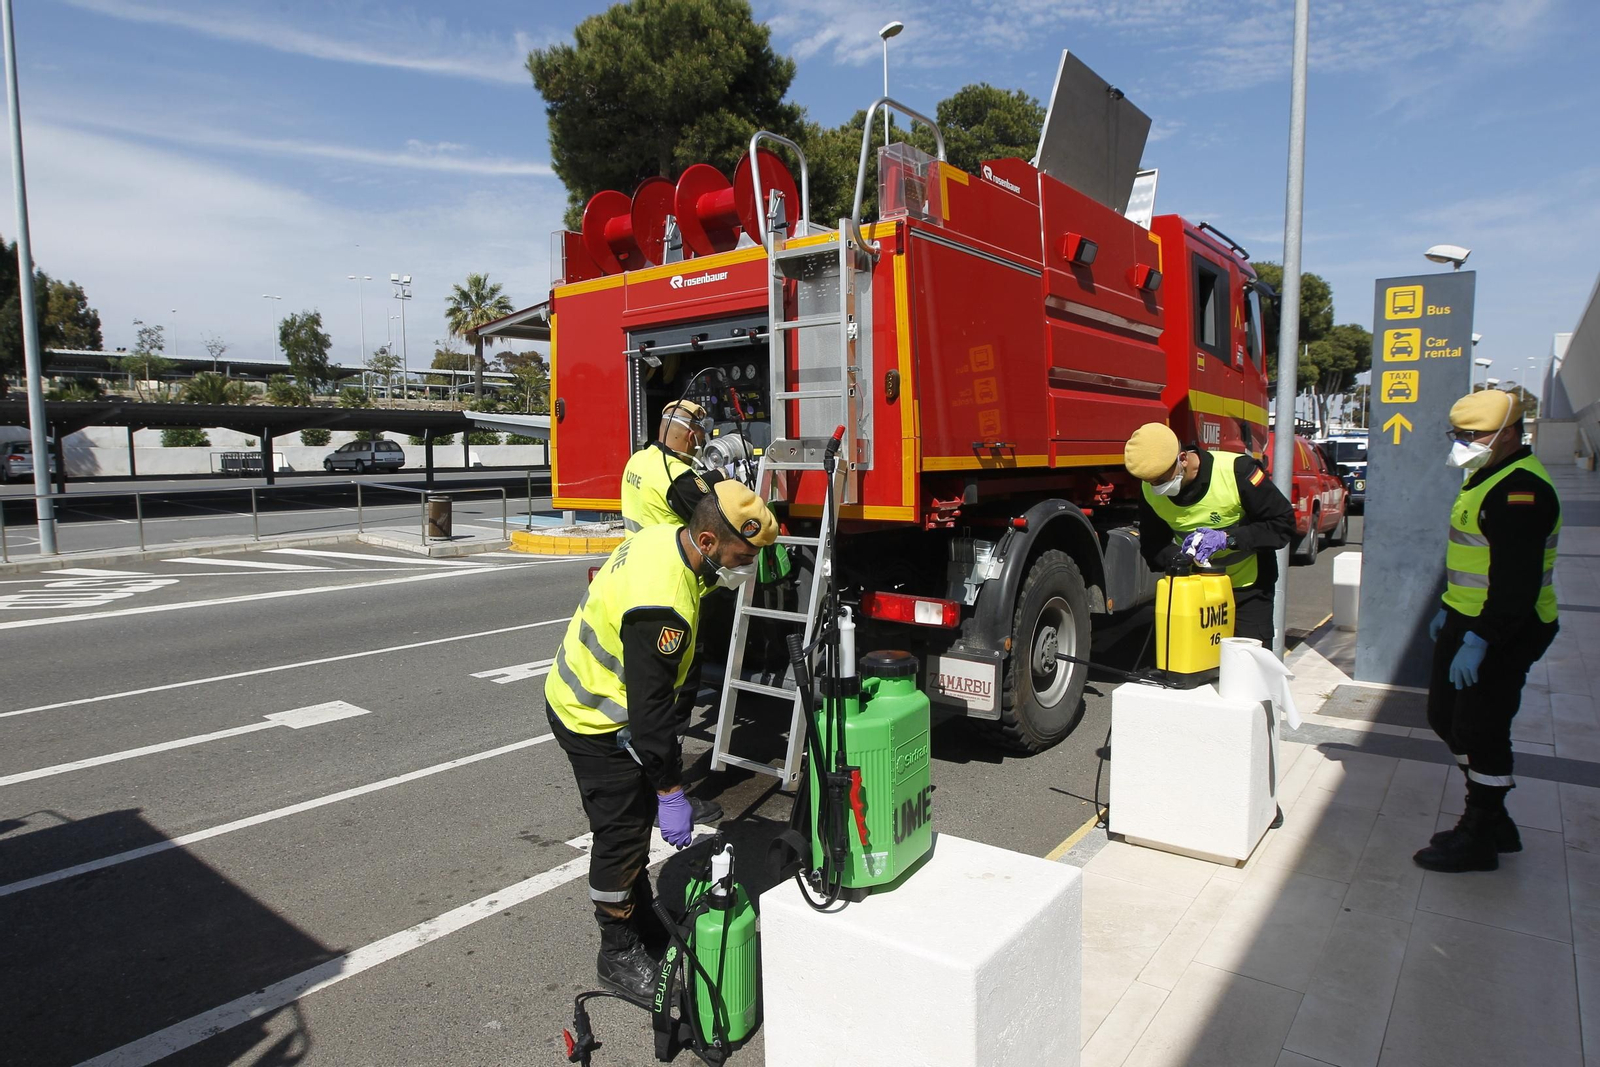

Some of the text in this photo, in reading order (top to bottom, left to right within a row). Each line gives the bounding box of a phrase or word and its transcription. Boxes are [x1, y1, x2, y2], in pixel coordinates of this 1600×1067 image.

[684, 272, 728, 287] rosenbauer
[1426, 305, 1451, 315] Bus
[1424, 347, 1462, 358] rental
[1425, 337, 1448, 347] Car
[1203, 423, 1221, 444] UME
[626, 469, 642, 490] UME
[1199, 601, 1228, 629] UME
[1210, 632, 1221, 646] 16
[929, 672, 992, 695] ZAMARBU
[893, 785, 931, 845] UME
[654, 962, 672, 1013] Sirfran
